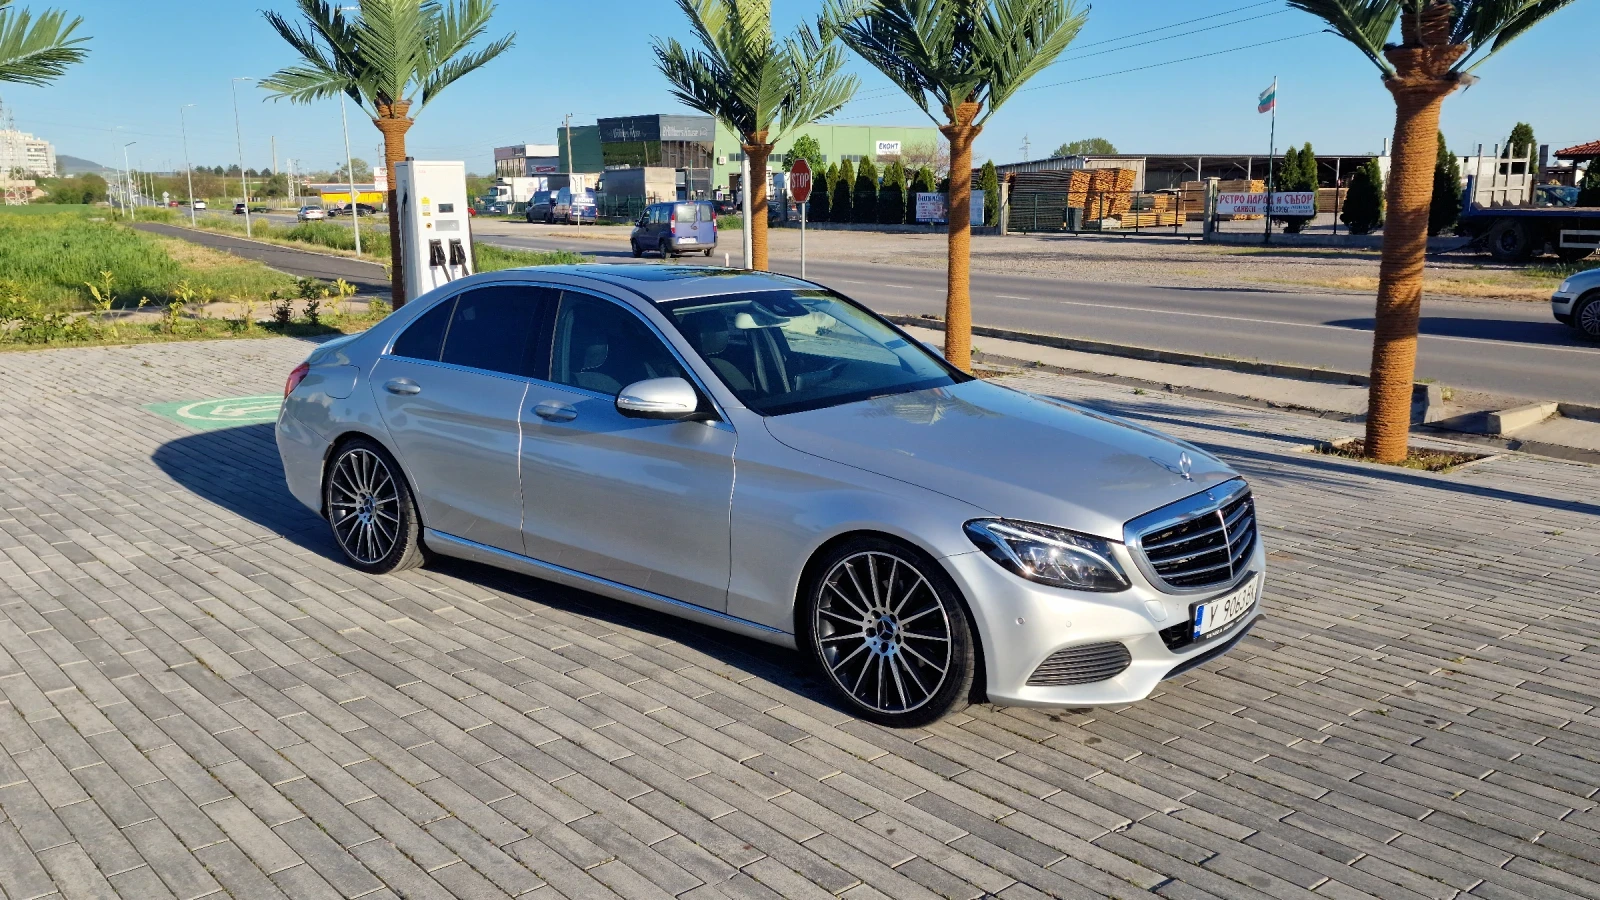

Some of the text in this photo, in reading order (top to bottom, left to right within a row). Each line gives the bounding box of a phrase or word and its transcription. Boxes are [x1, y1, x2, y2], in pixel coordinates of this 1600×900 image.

[792, 173, 810, 188] STOP
[1219, 194, 1245, 204] РЕТРО
[1285, 194, 1313, 204] СЪБОР
[1224, 589, 1247, 621] 9063
